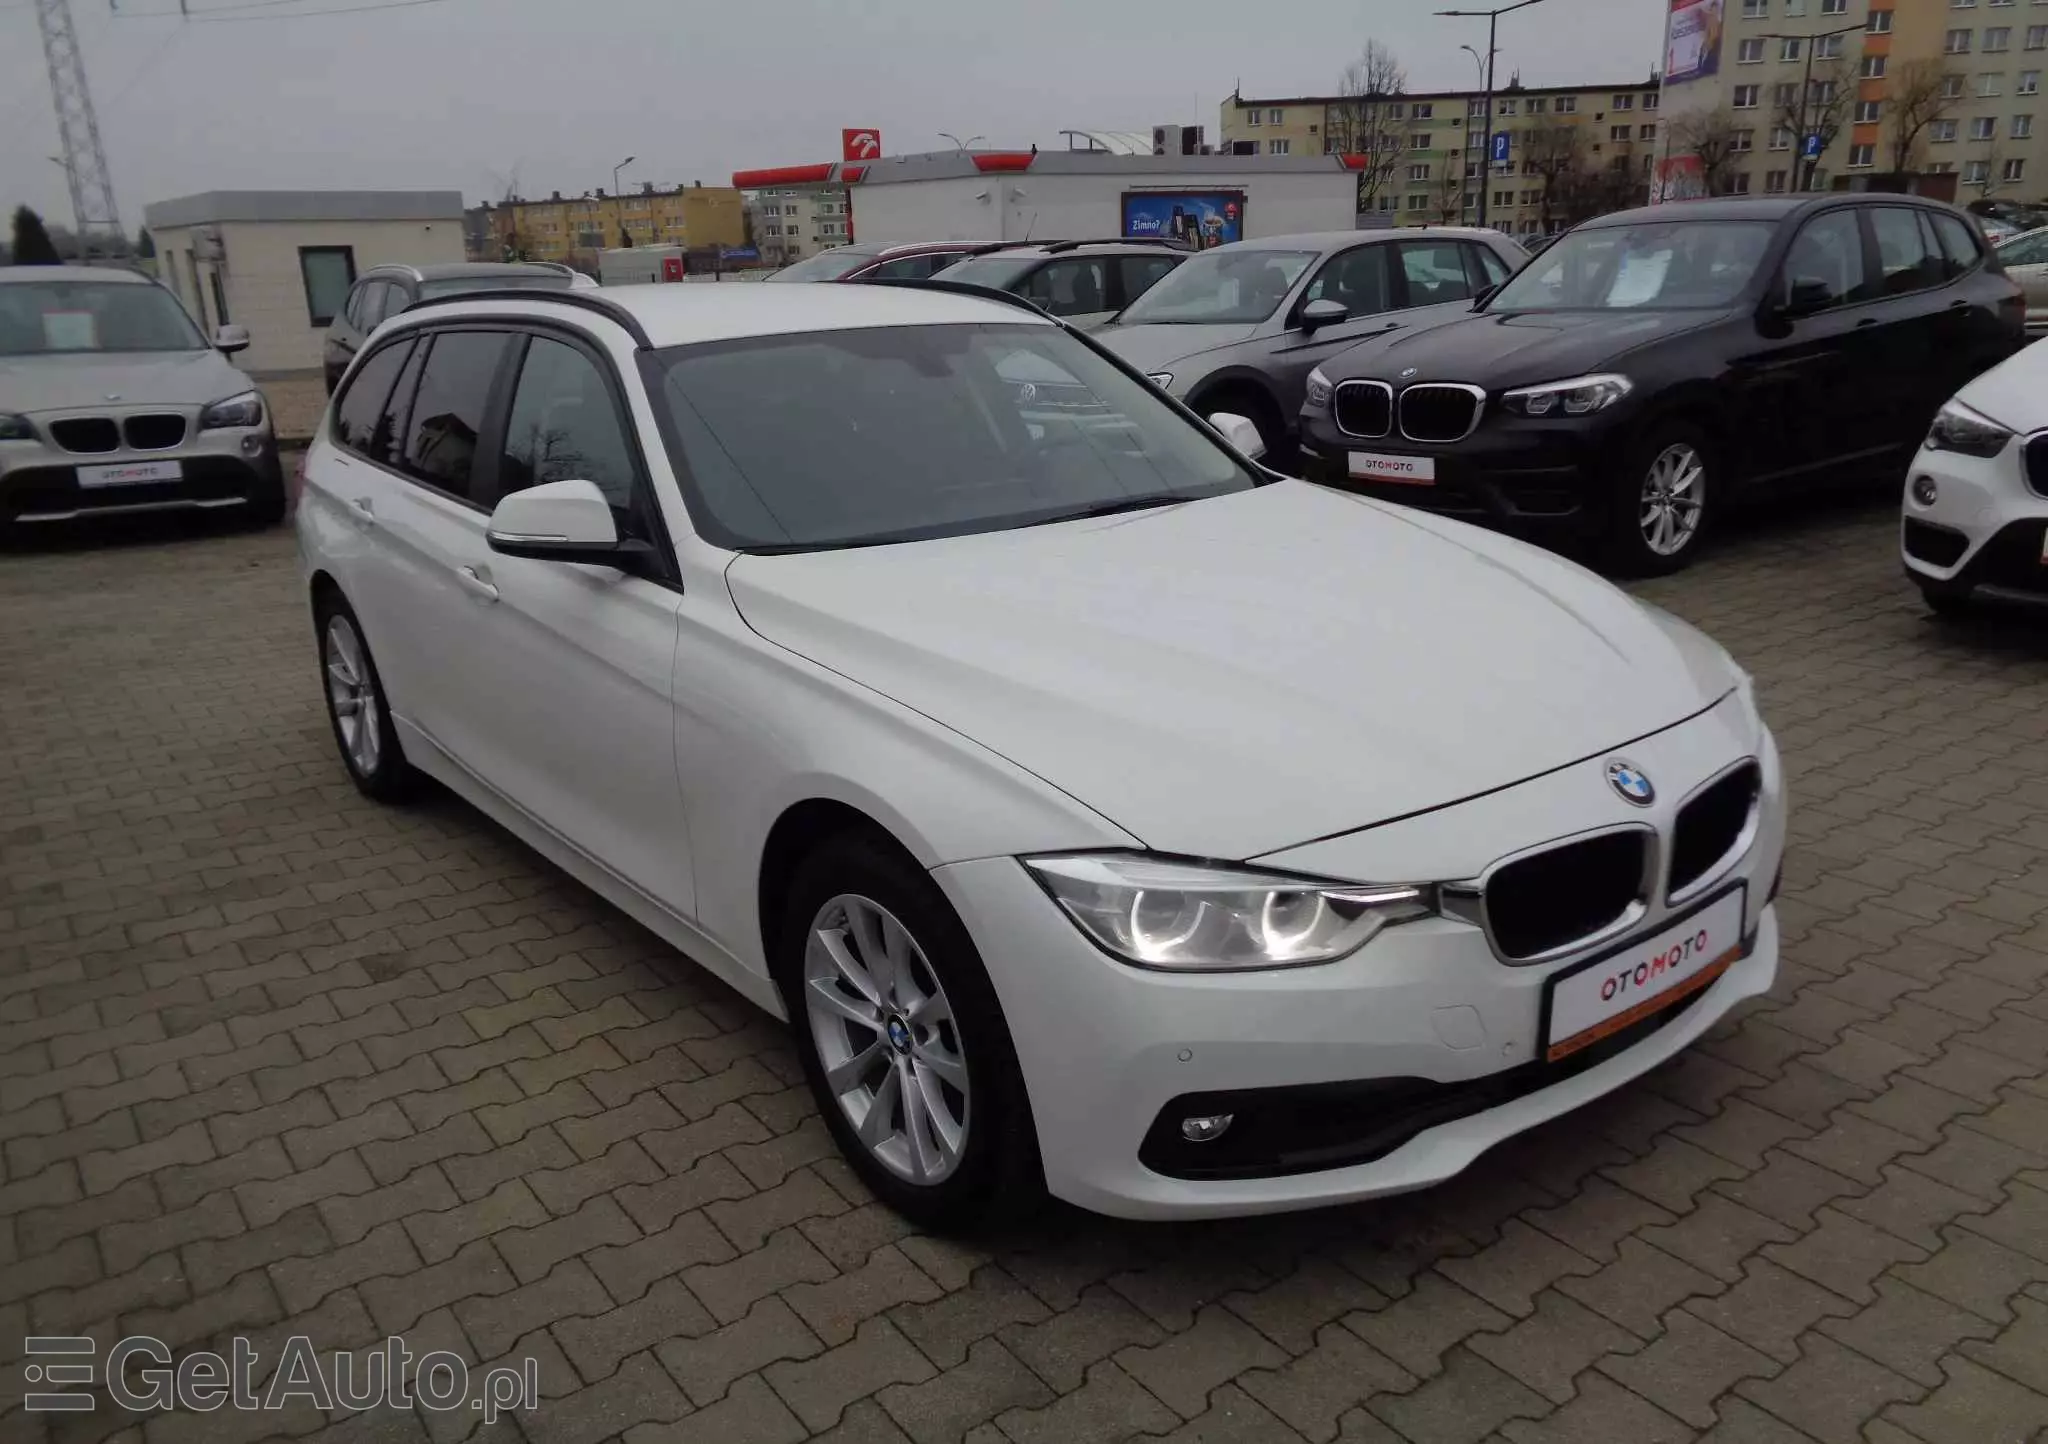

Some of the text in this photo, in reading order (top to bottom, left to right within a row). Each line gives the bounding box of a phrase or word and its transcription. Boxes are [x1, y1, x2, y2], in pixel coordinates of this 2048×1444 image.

[1496, 136, 1505, 158] P
[1807, 136, 1817, 153] P
[1132, 219, 1160, 231] Zimno?
[1365, 459, 1413, 472] OTOMOTO
[1601, 929, 1708, 1001] OTOMOTO
